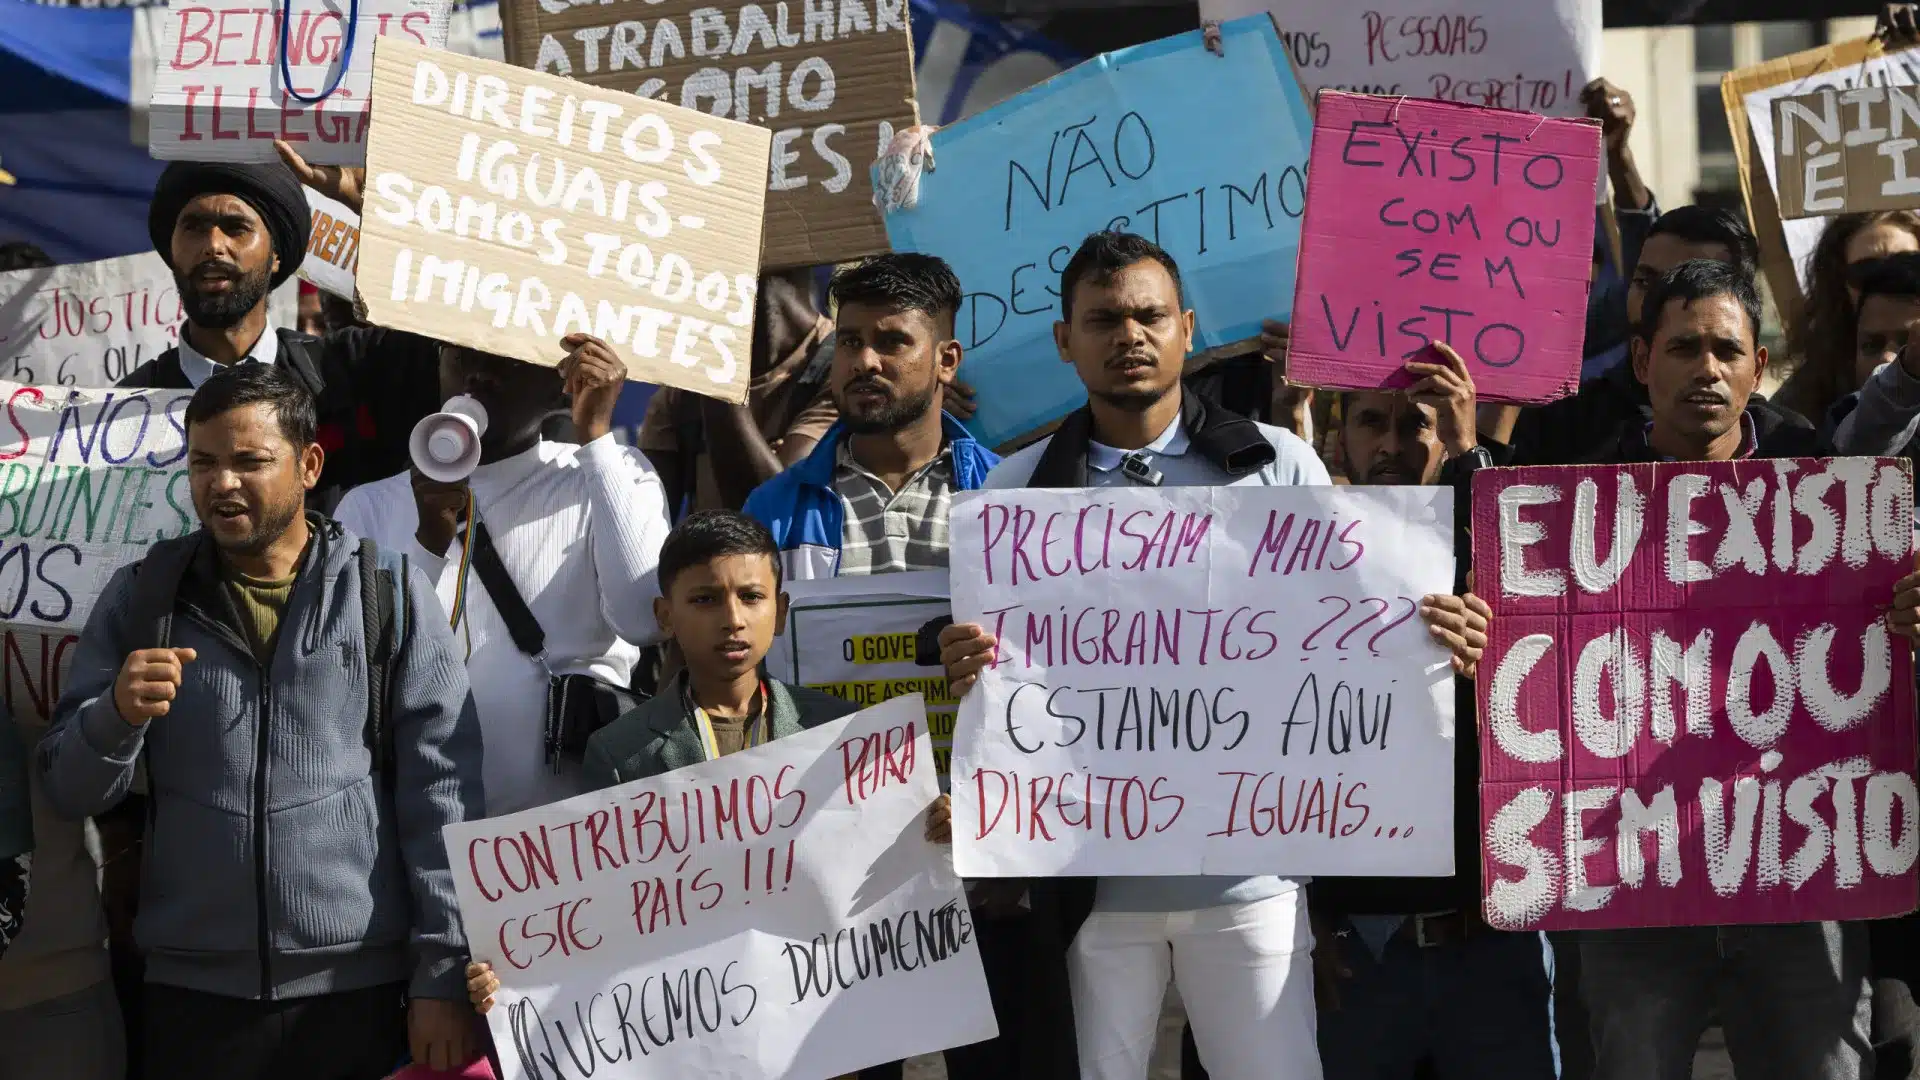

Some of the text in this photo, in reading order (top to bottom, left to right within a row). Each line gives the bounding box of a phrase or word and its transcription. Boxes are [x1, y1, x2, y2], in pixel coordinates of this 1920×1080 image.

[169, 6, 342, 71] BEING
[1361, 10, 1488, 65] PESSOAS
[412, 59, 722, 186] DIREITOS
[1005, 111, 1155, 231] NÃO
[374, 172, 757, 327] SOMOS TODOS
[1379, 197, 1560, 247] COM OU
[390, 249, 737, 384] IMIGRANTES
[1498, 472, 1645, 600] EU
[843, 635, 919, 661] O GOVE
[1300, 596, 1417, 661] ???
[854, 683, 876, 705] DE
[1005, 682, 1250, 756] ESTAMOS
[1489, 618, 1892, 764] COM OU
[837, 721, 916, 804] PARA
[1485, 783, 1683, 929] SEM
[498, 898, 602, 970] ESTE
[508, 960, 757, 1080] QUEREMOS
